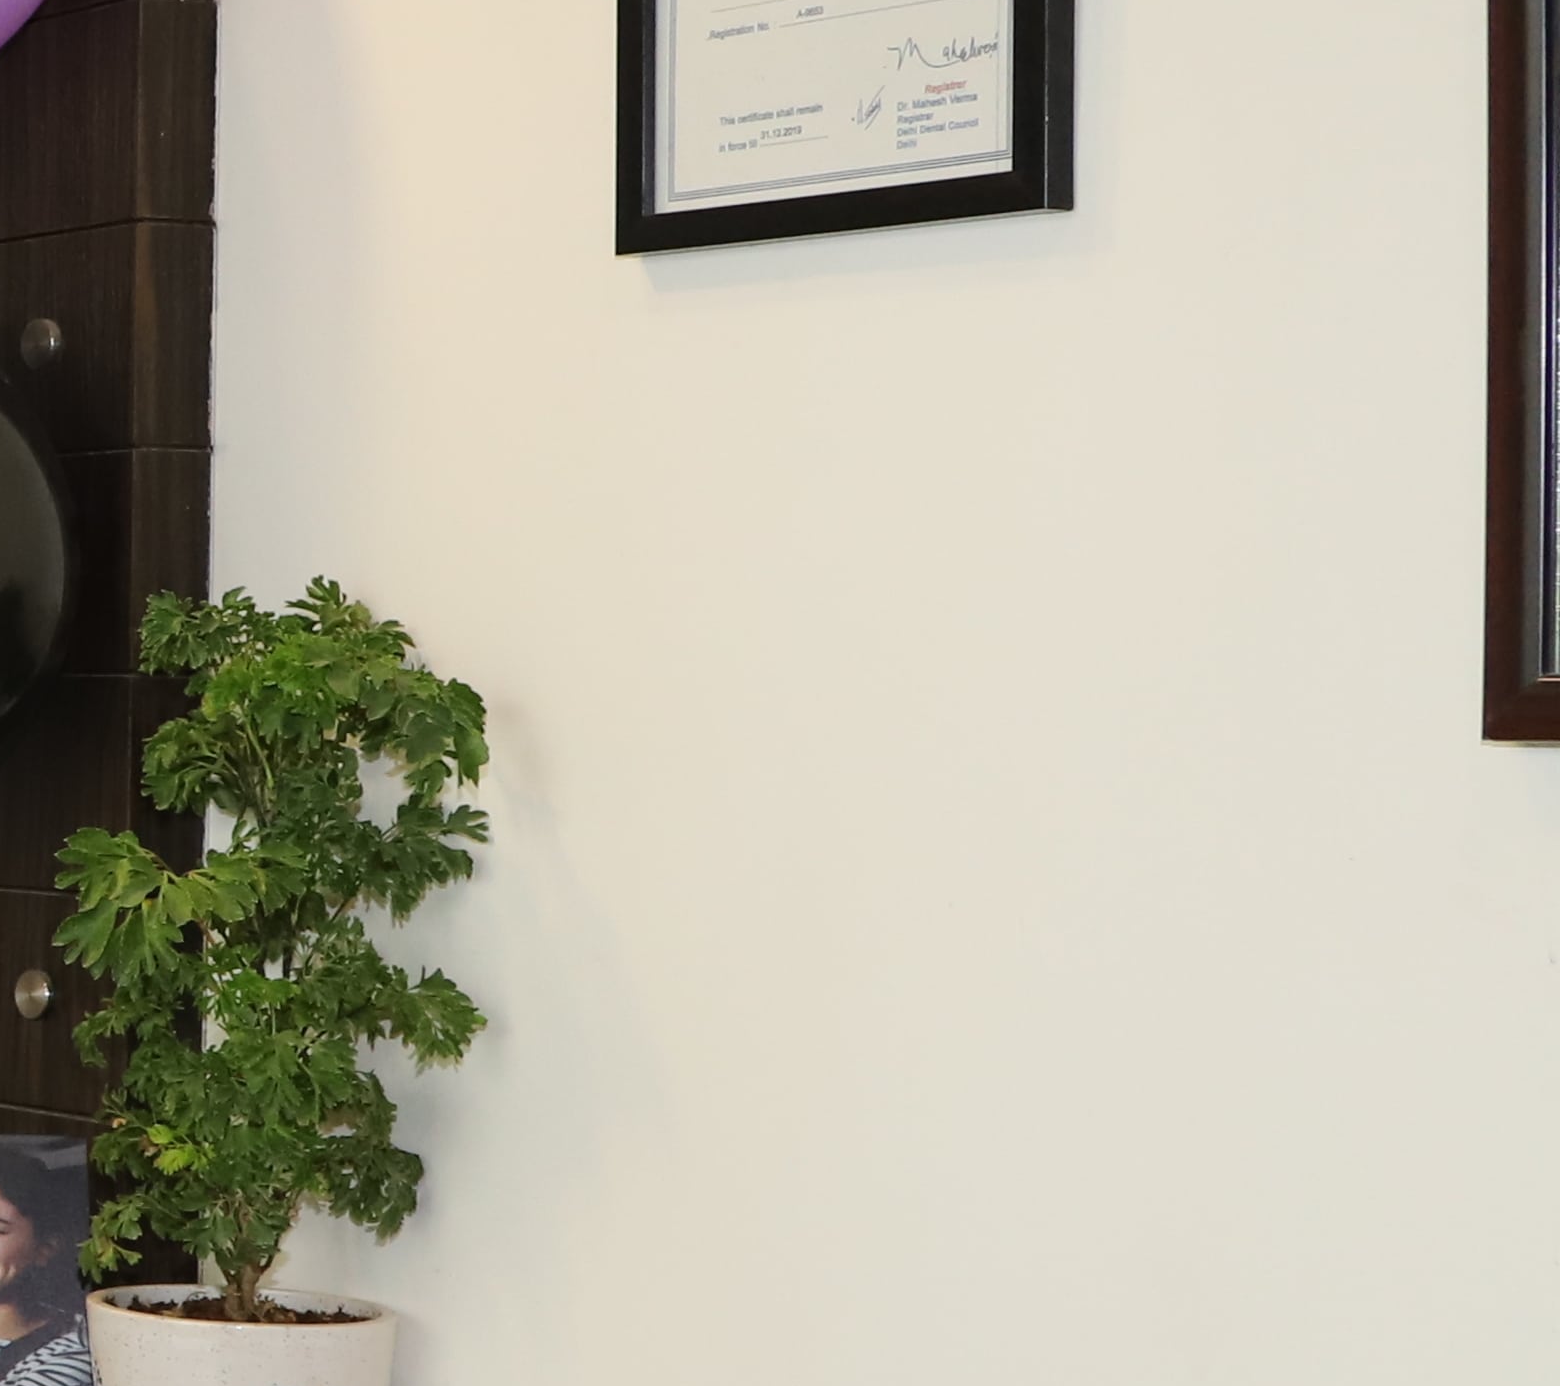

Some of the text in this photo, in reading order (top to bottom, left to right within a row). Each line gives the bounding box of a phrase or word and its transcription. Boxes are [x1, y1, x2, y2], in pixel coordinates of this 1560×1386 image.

[912, 93, 979, 110] Mahesh Verma
[897, 111, 934, 125] Registrar
[897, 117, 980, 138] Delhi Dental Council
[896, 139, 918, 151] Delhi
